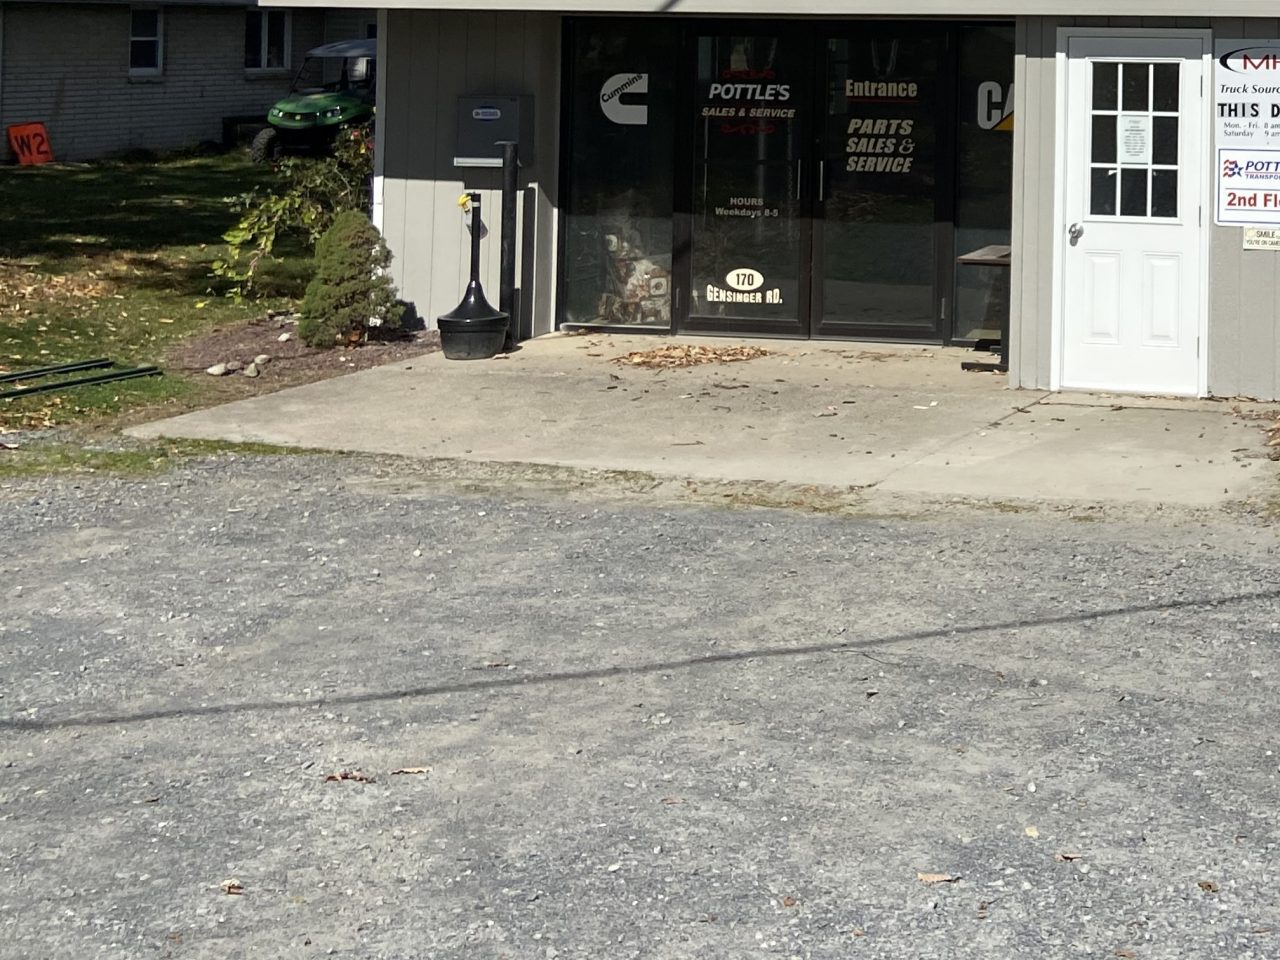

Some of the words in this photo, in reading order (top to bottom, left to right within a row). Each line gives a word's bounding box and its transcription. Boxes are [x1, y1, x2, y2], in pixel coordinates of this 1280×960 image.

[601, 73, 643, 103] Cummins
[709, 83, 790, 101] POTTLE'S
[845, 79, 918, 98] Entrance
[1220, 84, 1249, 94] Truck
[701, 106, 736, 117] SALES
[738, 107, 746, 117] &
[749, 107, 796, 118] SERVICE
[1217, 103, 1260, 118] THIS
[847, 118, 915, 135] PARTS
[1223, 130, 1254, 139] Saturday
[13, 132, 49, 157] W2
[846, 137, 896, 153] SALES
[898, 138, 916, 154] &
[846, 156, 914, 173] SERVICE
[729, 197, 764, 206] HOURS
[1227, 192, 1257, 207] 2nd
[715, 207, 762, 218] Weekdays
[1256, 230, 1276, 239] SMILE
[735, 272, 755, 286] 170
[707, 284, 763, 304] GENSINGER
[765, 287, 783, 304] RD.
